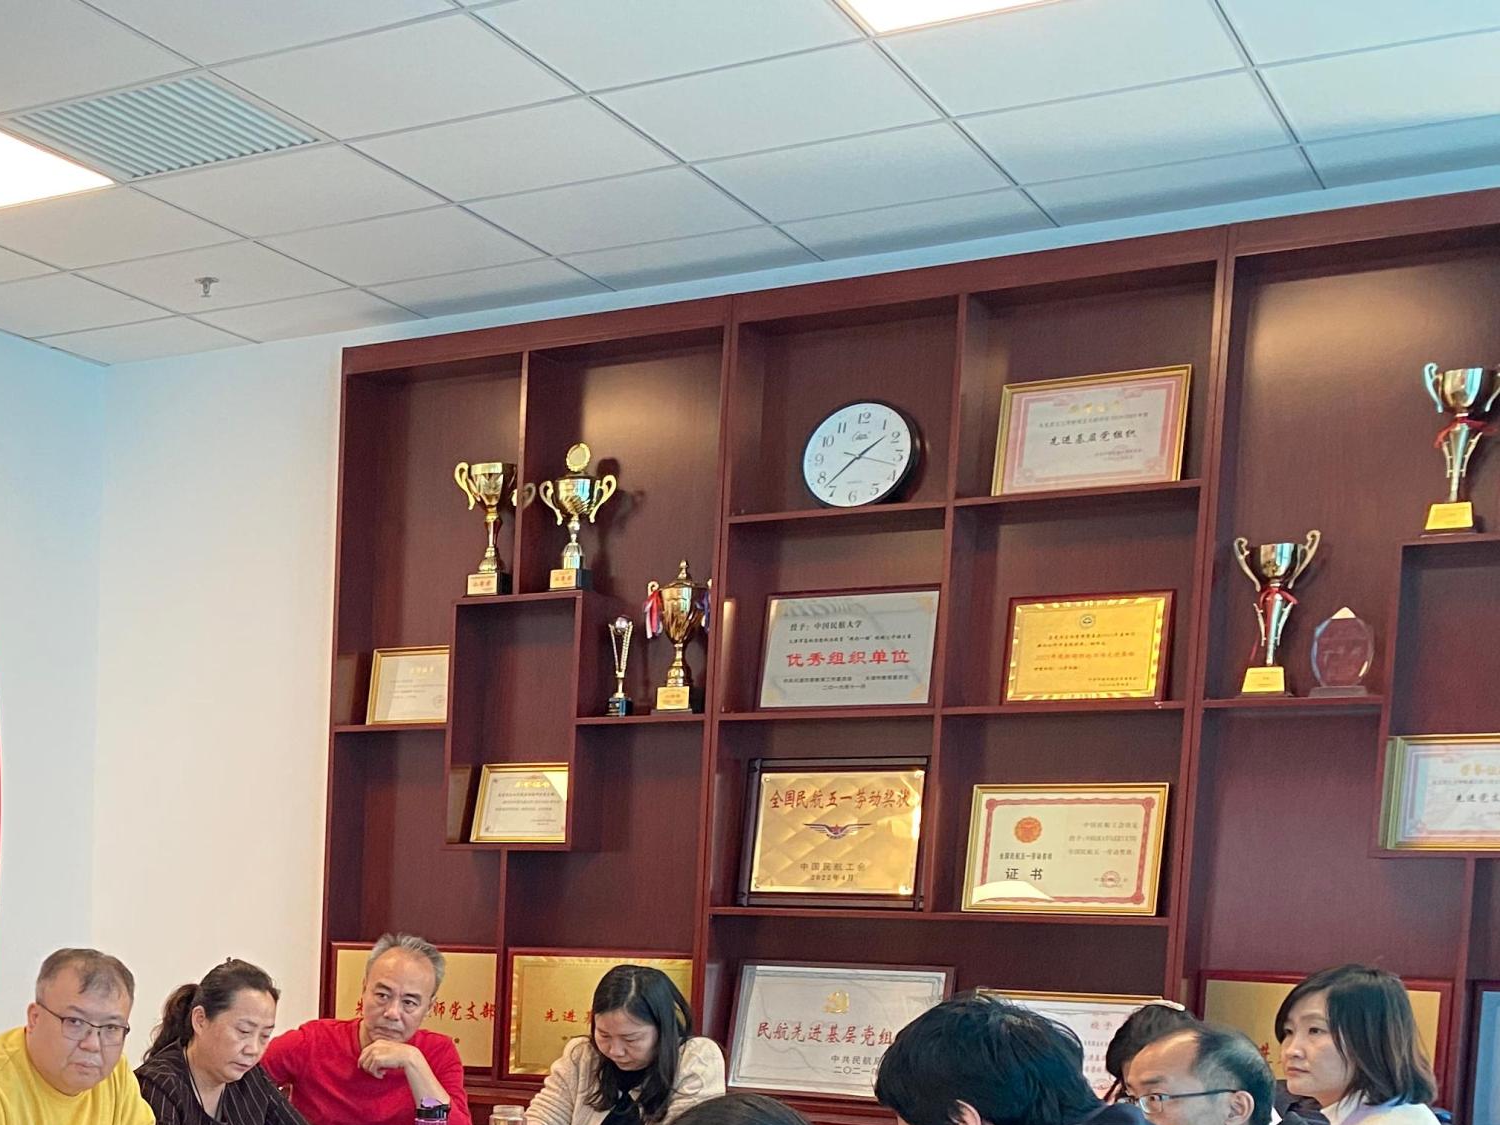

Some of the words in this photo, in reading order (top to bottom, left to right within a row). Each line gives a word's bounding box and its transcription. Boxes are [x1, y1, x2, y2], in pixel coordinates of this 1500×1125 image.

[858, 412, 871, 424] 12
[837, 422, 847, 433] 11
[882, 419, 887, 430] 1
[822, 435, 834, 447] 10
[890, 431, 900, 443] 2
[814, 453, 824, 465] 9
[894, 449, 903, 461] 3
[817, 472, 826, 484] 8
[887, 470, 896, 481] 4
[828, 485, 836, 497] 7
[870, 483, 879, 495] 5
[848, 491, 857, 502] 6
[786, 649, 911, 668] 优秀组织单位
[770, 788, 912, 809] 全国民航五一劳动奖状
[800, 862, 866, 872] 中国民航工会
[757, 1021, 896, 1047] 民航先进基层党组
